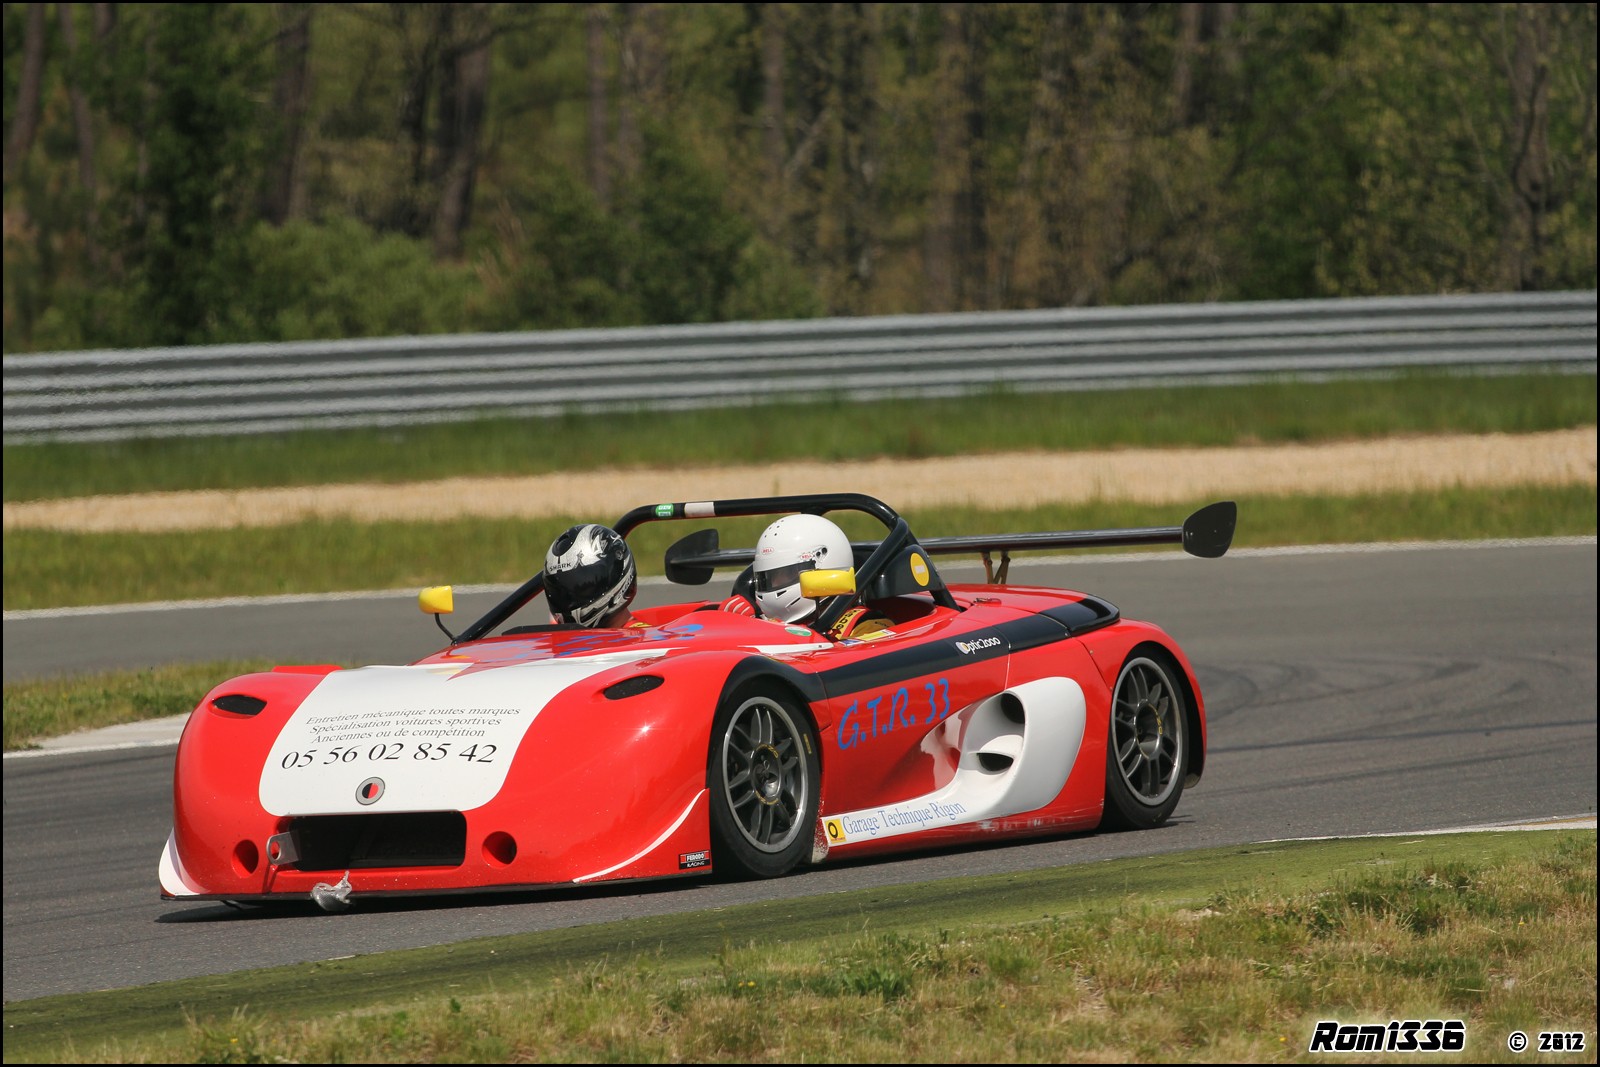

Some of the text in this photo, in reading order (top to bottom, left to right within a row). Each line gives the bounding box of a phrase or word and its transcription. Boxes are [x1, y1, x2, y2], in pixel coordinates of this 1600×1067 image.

[549, 562, 572, 571] SHARK
[306, 714, 359, 725] Entretien
[361, 708, 426, 719] mécanique
[468, 708, 521, 716] marques
[837, 687, 919, 750] G.T.R.
[925, 678, 951, 724] 33
[309, 716, 502, 735] Spécialisation voitures sportives
[311, 731, 373, 744] Anciennes
[394, 728, 409, 737] de
[412, 727, 485, 738] compétition
[281, 742, 497, 769] 05 56 02 85 42
[842, 801, 967, 836] Garage Technique Rigon
